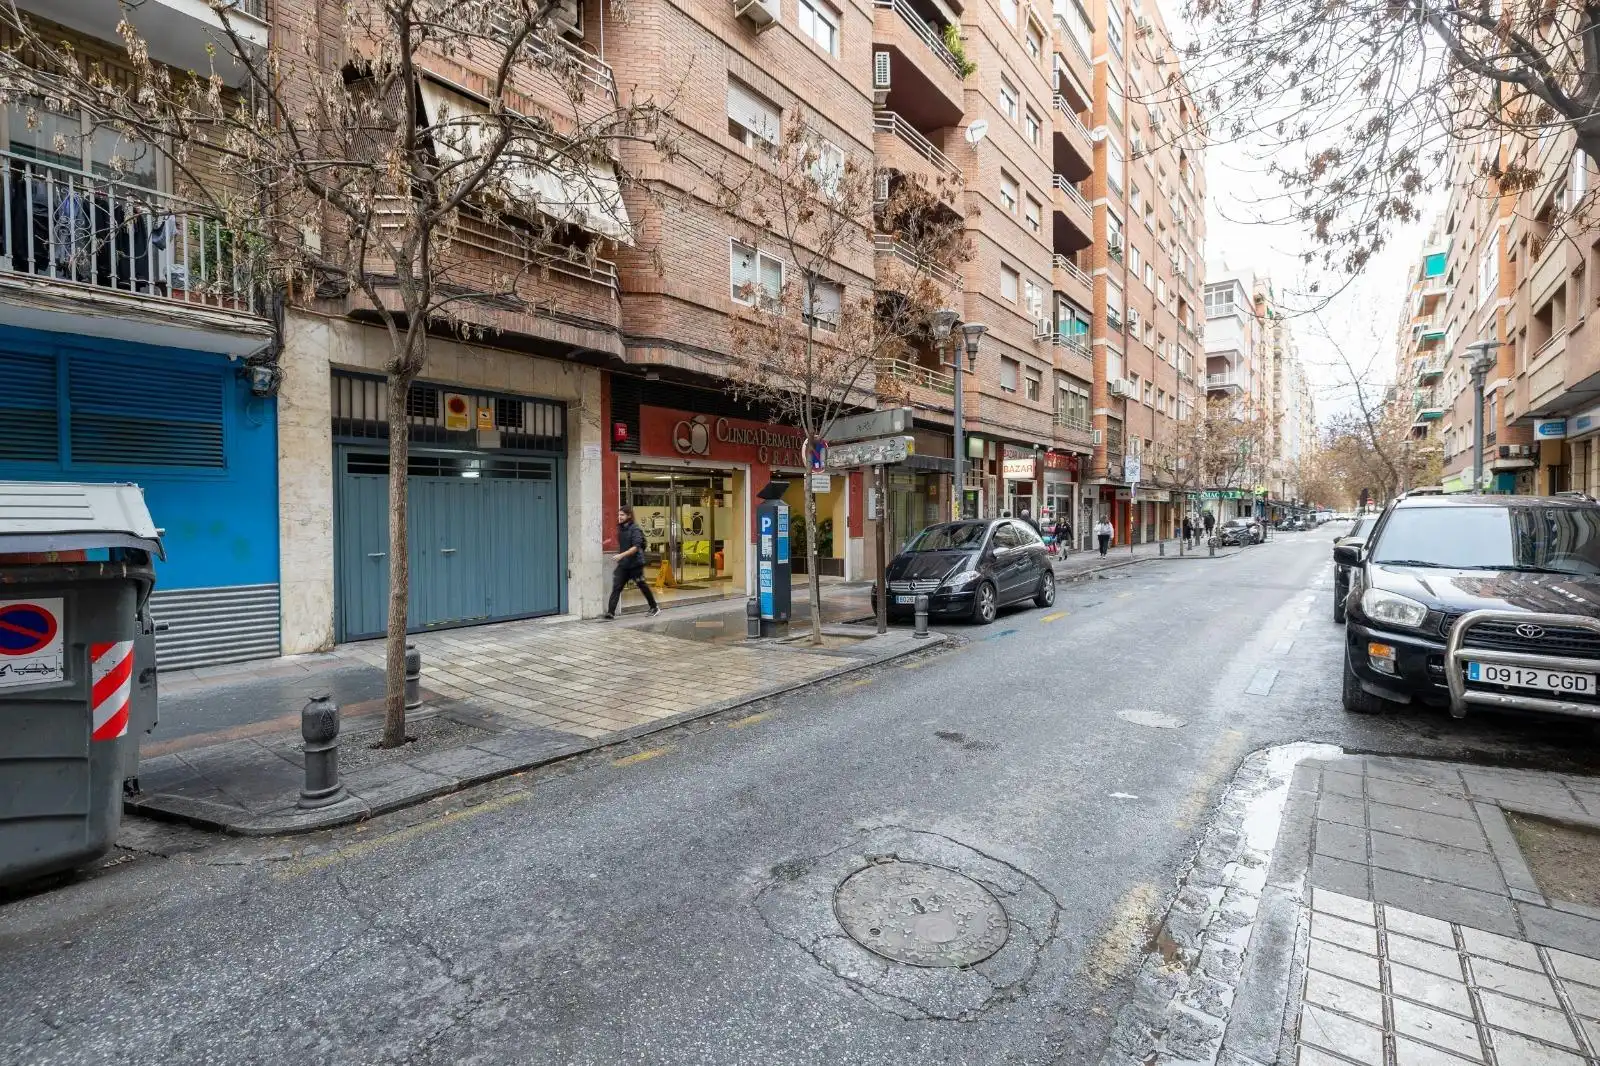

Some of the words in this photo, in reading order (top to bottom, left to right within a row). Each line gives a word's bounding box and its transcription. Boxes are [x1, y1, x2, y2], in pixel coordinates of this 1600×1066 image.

[759, 446, 801, 466] GRAN
[1003, 464, 1033, 473] BAZAR
[761, 517, 772, 532] P
[1486, 666, 1538, 686] 0912
[1547, 673, 1588, 691] CGD
